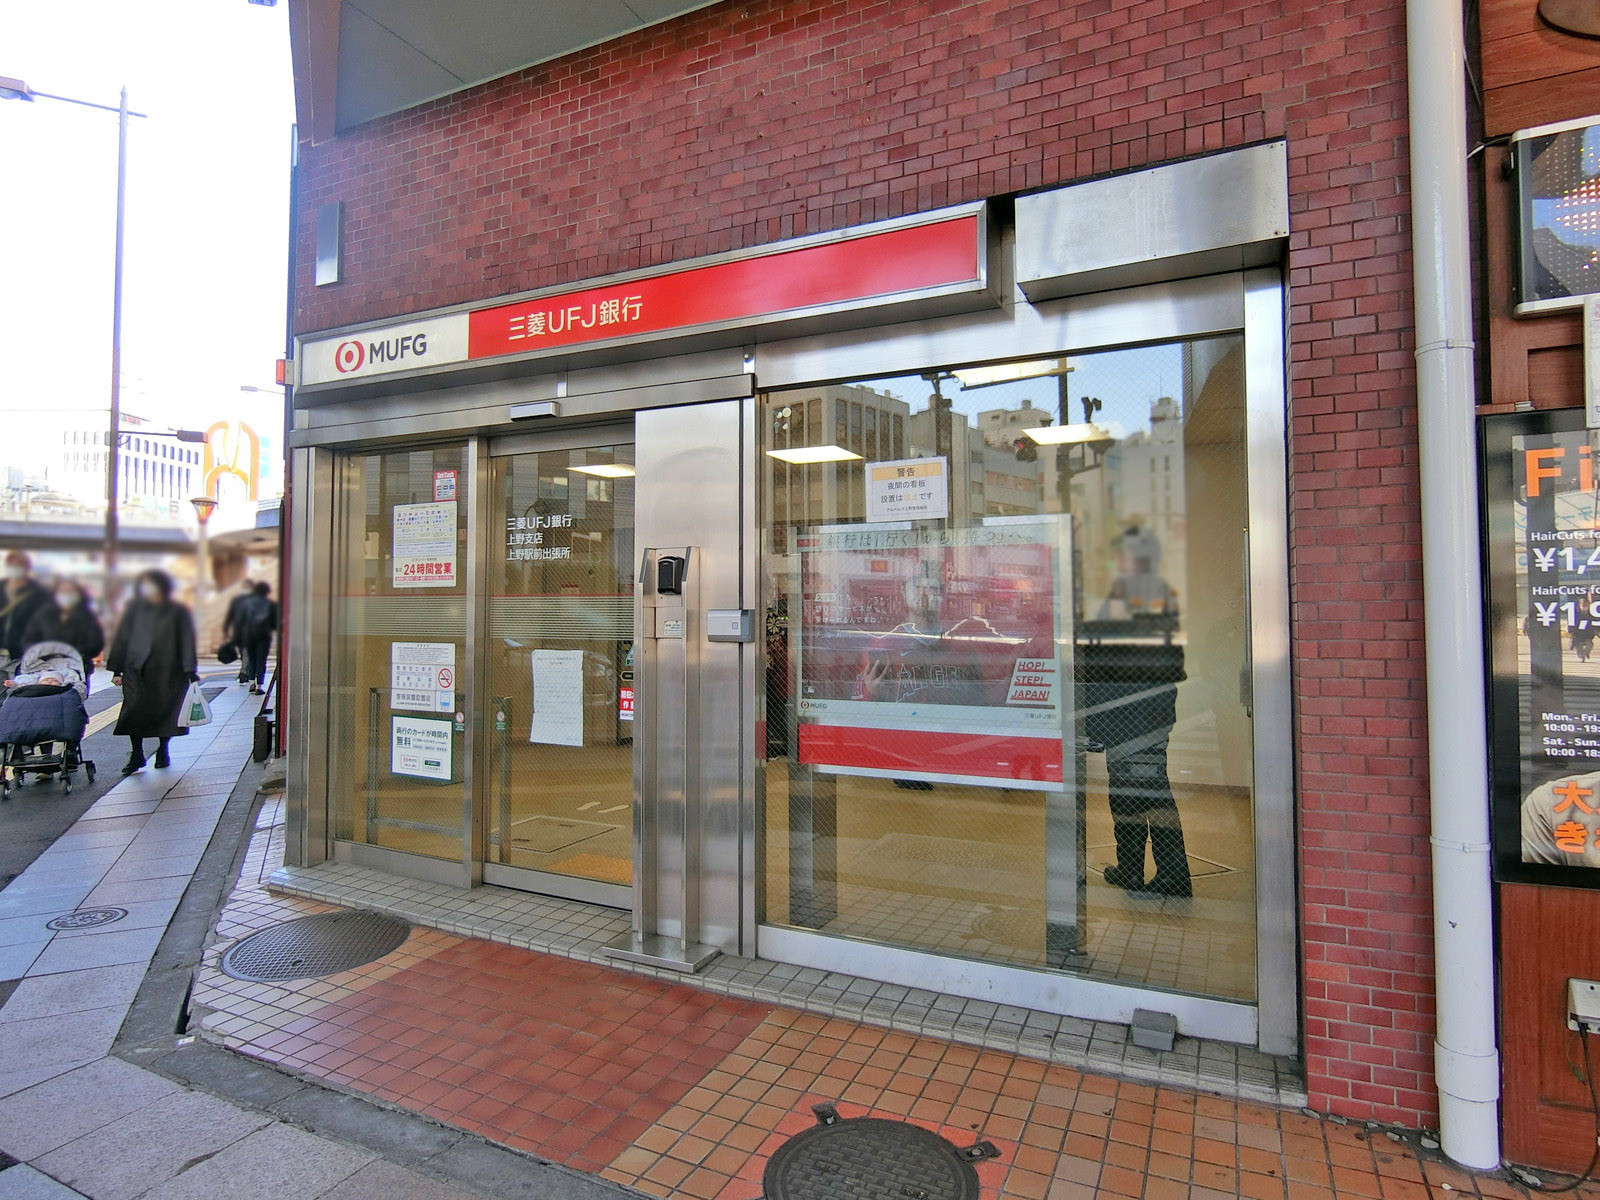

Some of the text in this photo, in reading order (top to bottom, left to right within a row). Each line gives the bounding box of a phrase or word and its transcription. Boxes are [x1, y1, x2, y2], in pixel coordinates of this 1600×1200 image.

[508, 296, 643, 340] 三菱UFJ銀行
[369, 333, 427, 364] MUFG
[897, 467, 915, 477] 警告
[1525, 445, 1593, 497] Fi
[887, 480, 926, 490] 夜間の看板
[506, 515, 572, 530] 三菱UFJ銀行
[506, 532, 543, 545] 上野支店
[1531, 530, 1586, 541] HairCuts
[506, 547, 571, 560] 上野駅前出張所
[403, 562, 452, 575] 24時間営業
[1532, 586, 1587, 596] HairCuts
[1018, 662, 1045, 670] HOP!
[1015, 676, 1043, 684] STEP!
[1011, 690, 1050, 699] JAPAN!
[1542, 713, 1572, 721] Mon.
[1581, 714, 1600, 722] Fri.
[1544, 723, 1575, 732] 10:00
[396, 736, 411, 746] 無料
[1542, 737, 1566, 746] Sat.
[1574, 738, 1600, 746] Sun.
[1544, 748, 1576, 756] 10:00
